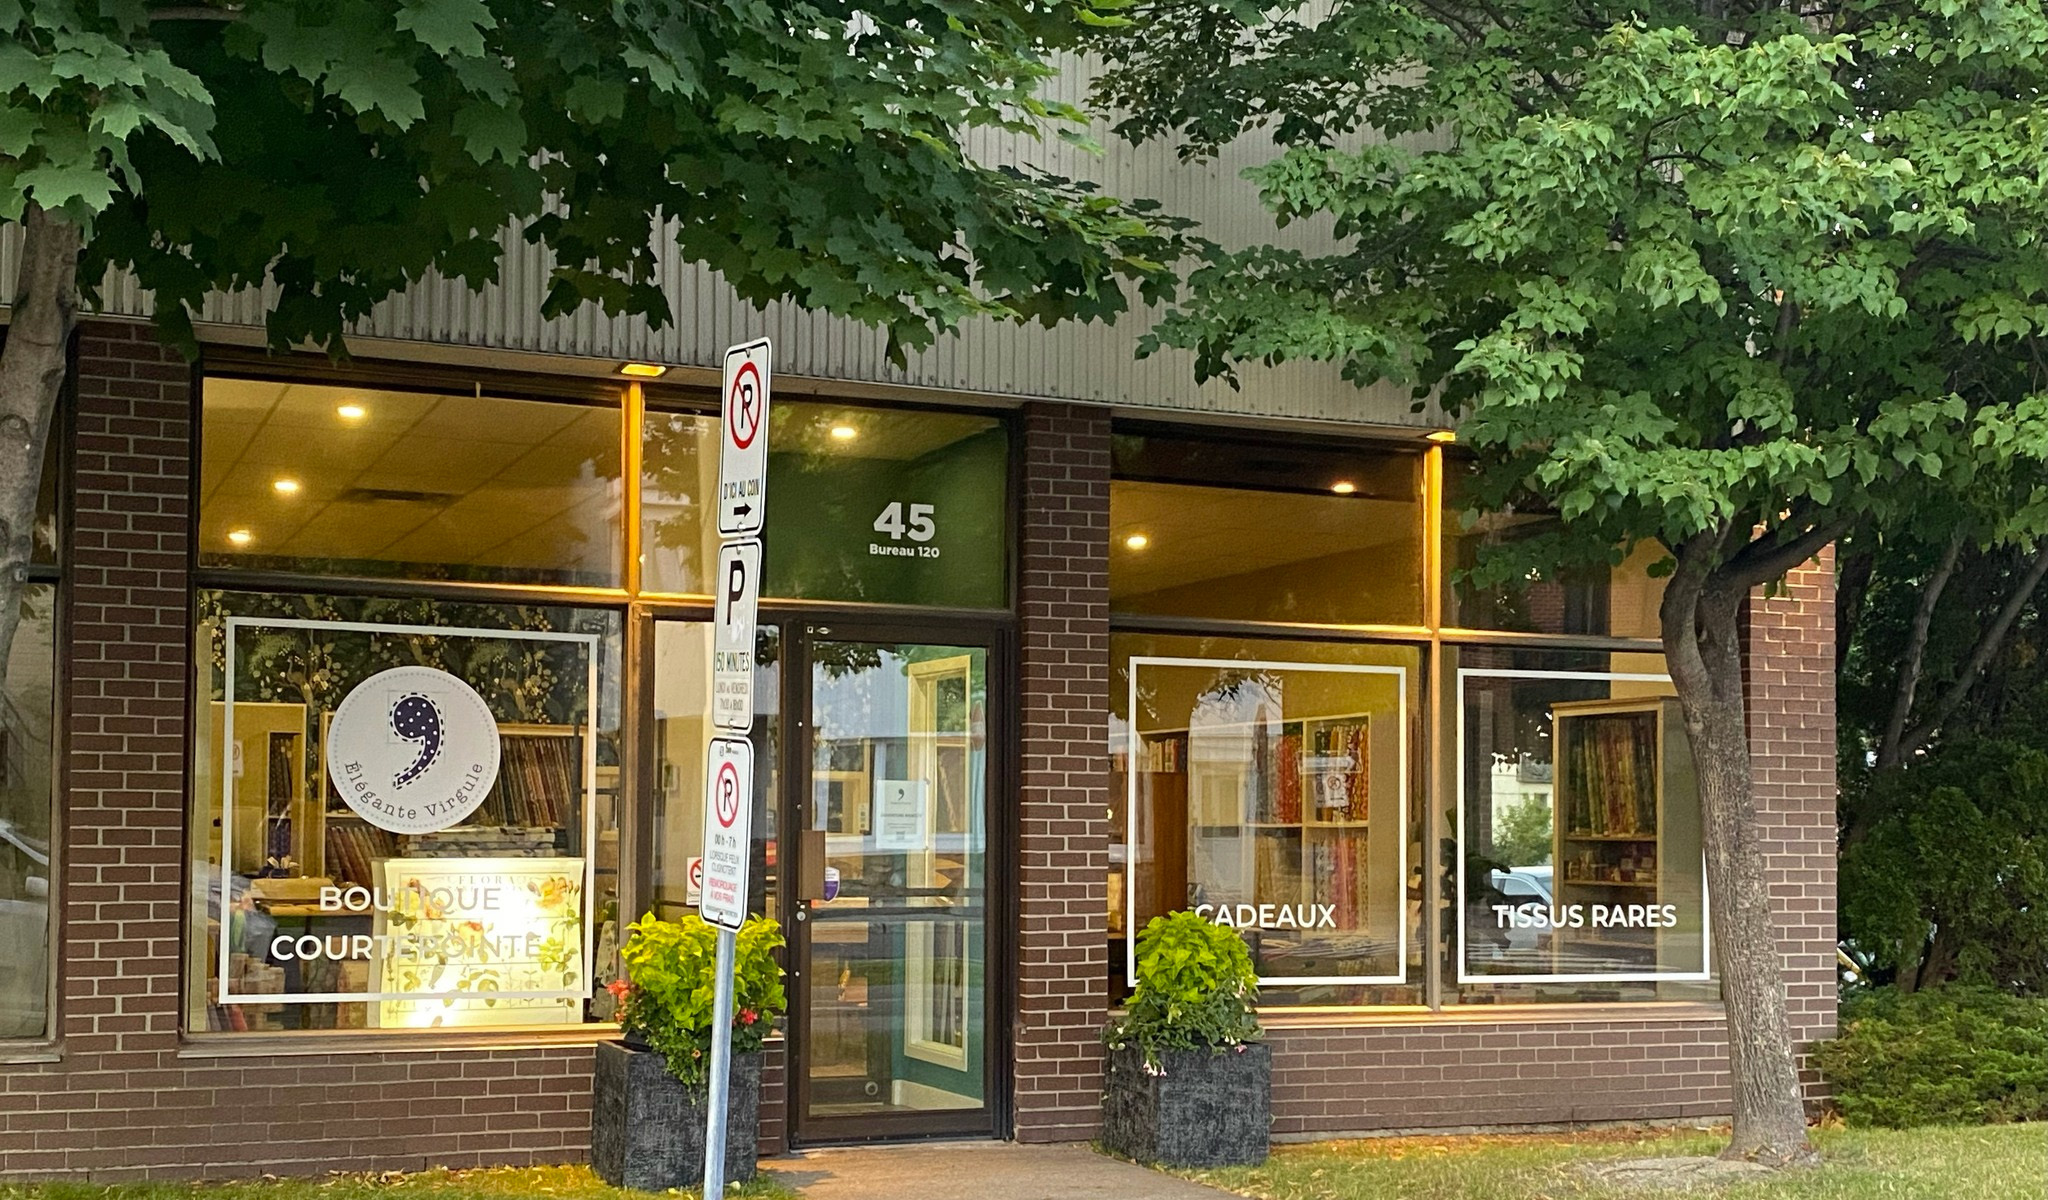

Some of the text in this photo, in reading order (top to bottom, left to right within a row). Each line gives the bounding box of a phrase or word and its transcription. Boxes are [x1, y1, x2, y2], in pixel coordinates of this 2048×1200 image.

[740, 383, 753, 429] P
[723, 478, 760, 500] D'ICI AU COIN
[873, 501, 936, 542] 45
[869, 543, 941, 558] Bureau 120
[726, 560, 746, 625] P
[726, 651, 750, 672] MINUTES
[344, 760, 483, 820] Élégante Virgule
[723, 778, 733, 812] P
[459, 875, 515, 885] FLORA
[319, 886, 501, 914] BOUTIQUE
[1194, 904, 1336, 928] CADEAUX
[1491, 904, 1678, 928] TISSUS RARES
[270, 935, 542, 960] COURTEPOINTE
